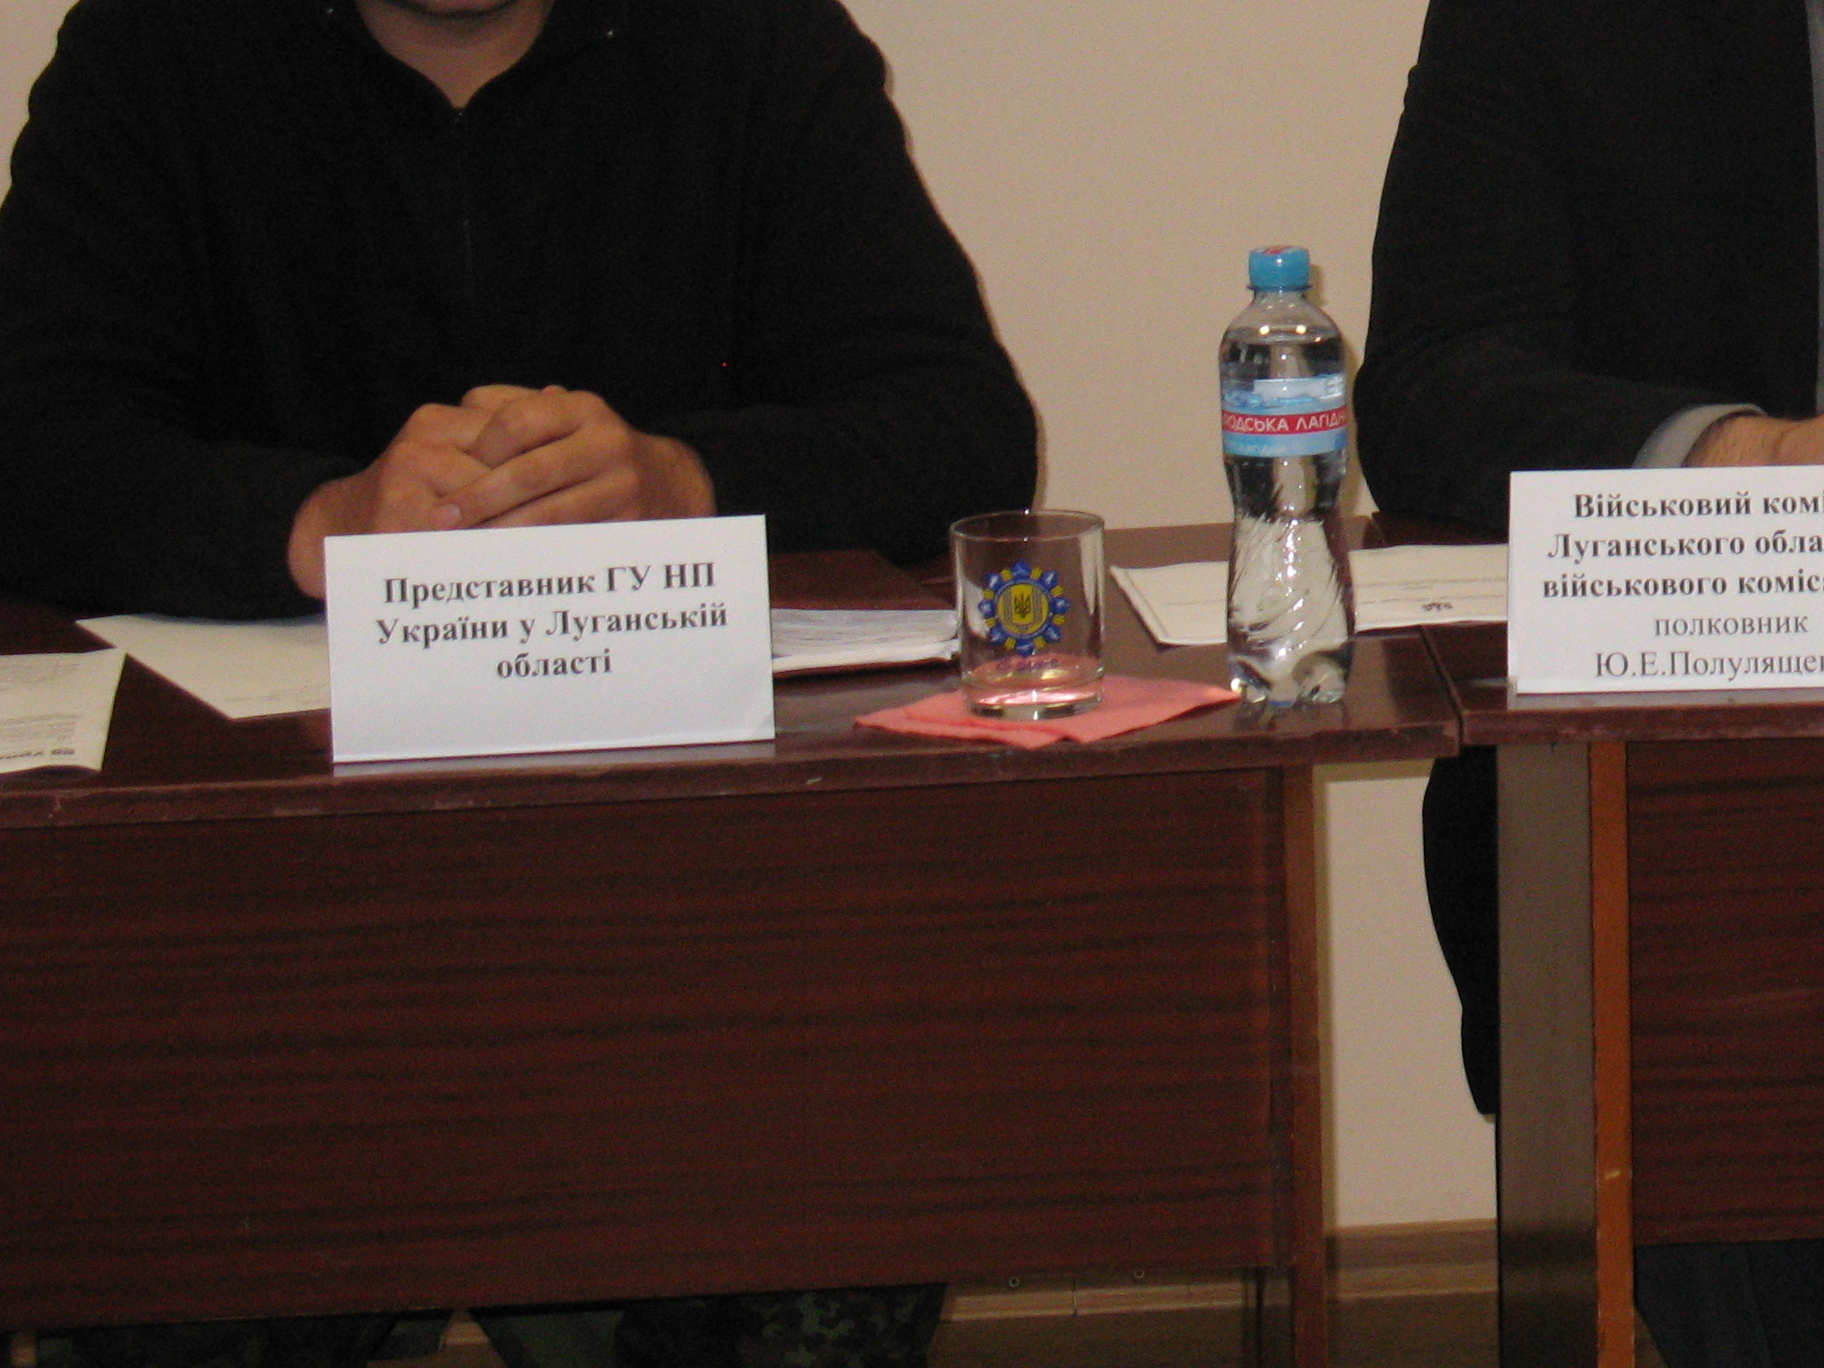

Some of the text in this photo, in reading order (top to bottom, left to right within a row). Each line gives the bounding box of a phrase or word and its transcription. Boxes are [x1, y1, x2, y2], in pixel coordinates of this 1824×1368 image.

[1222, 413, 1290, 432] ОДСЬКА
[1574, 491, 1752, 519] Військовий
[1547, 533, 1746, 565] Луганського
[384, 562, 716, 610] Представник ГУ НП
[1542, 574, 1728, 599] військового
[376, 602, 728, 650] України у Луганській
[1655, 615, 1808, 637] полковник
[496, 648, 612, 679] області
